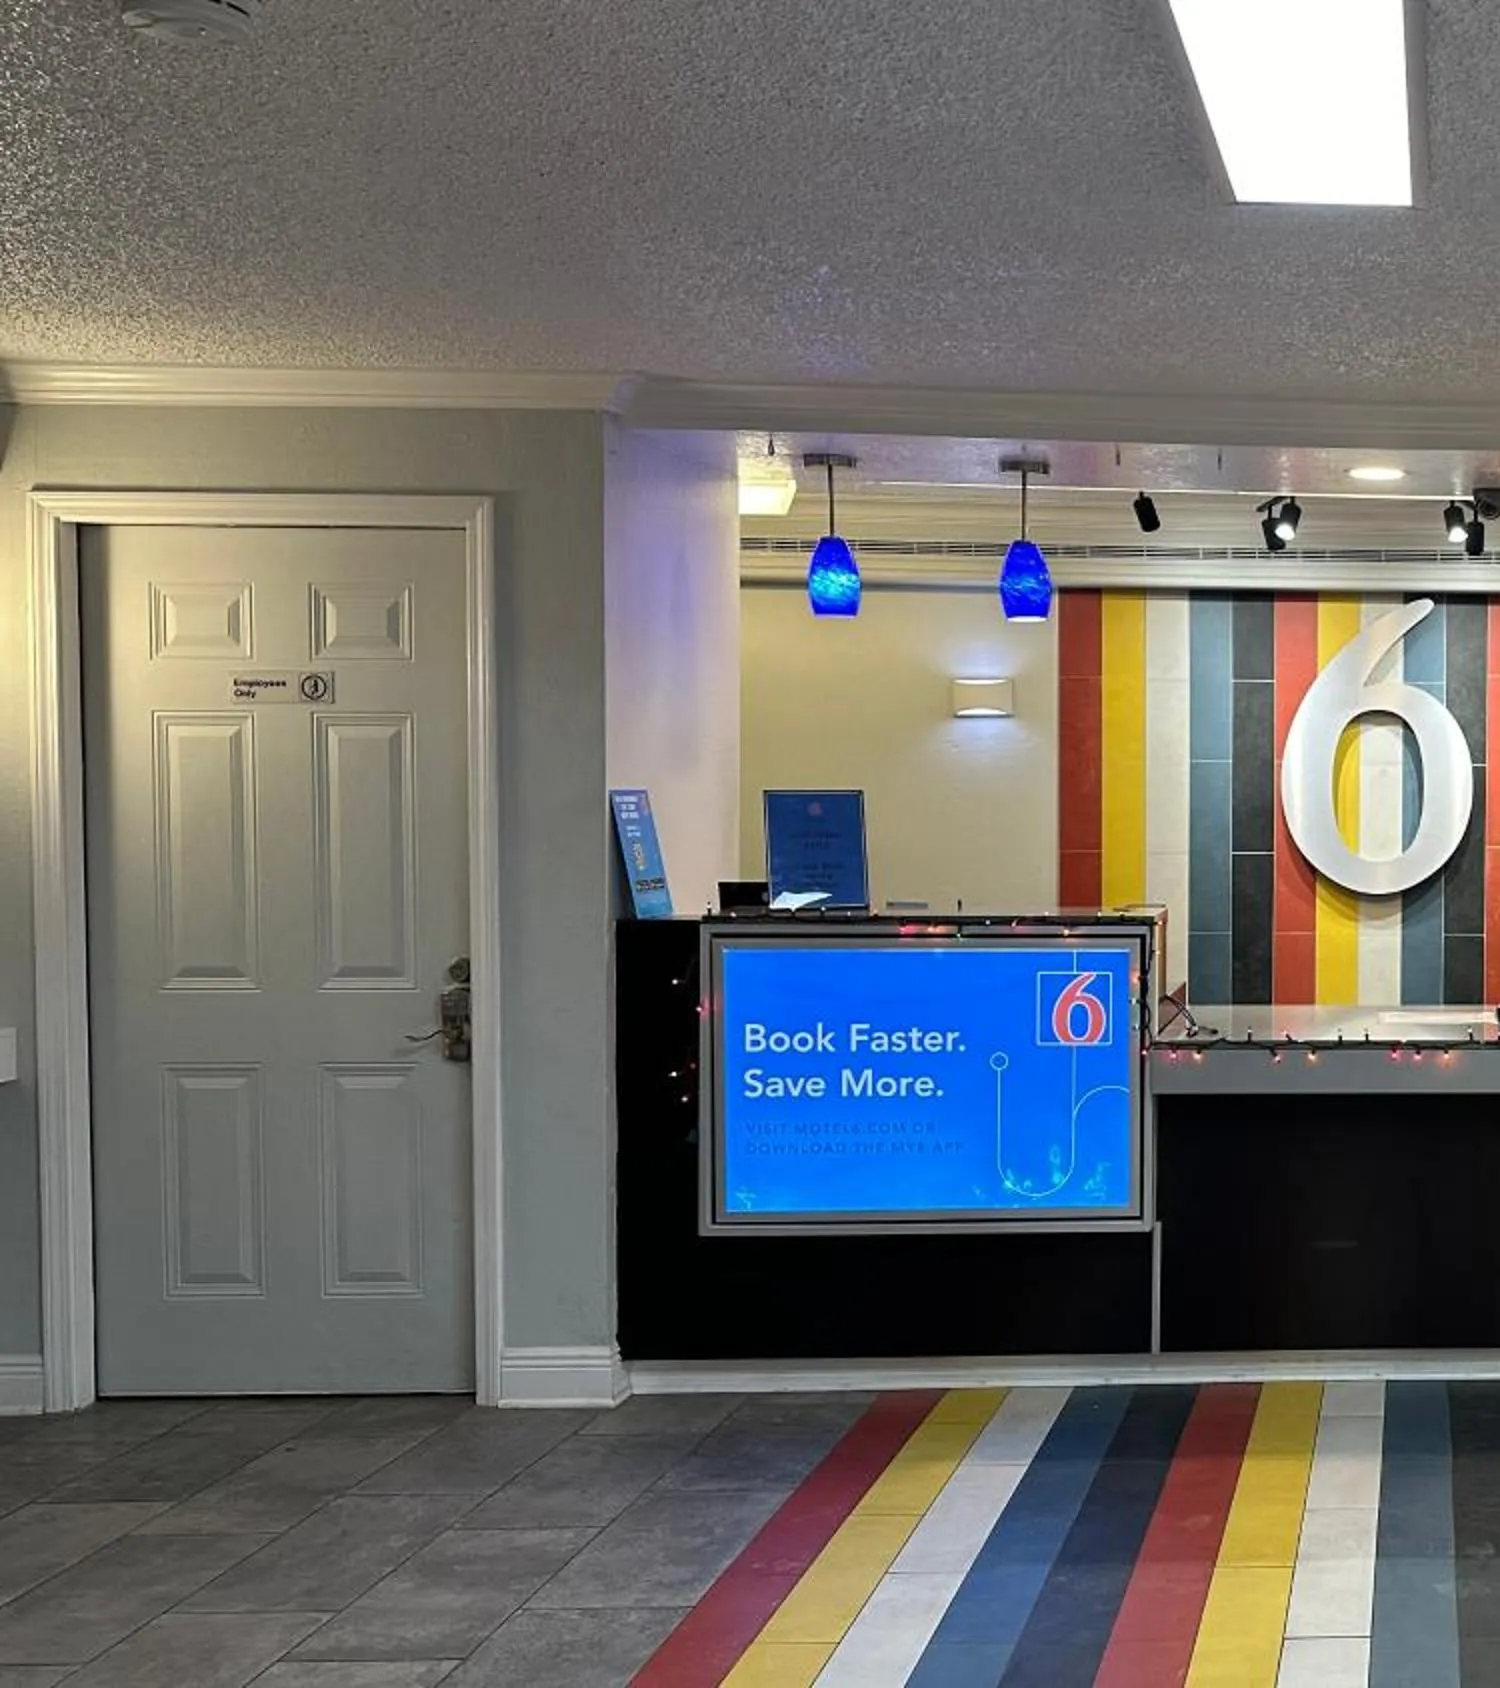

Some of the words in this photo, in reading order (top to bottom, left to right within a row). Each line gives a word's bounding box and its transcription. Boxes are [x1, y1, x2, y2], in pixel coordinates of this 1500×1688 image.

[233, 678, 287, 688] Employees
[233, 688, 257, 698] Only
[1281, 598, 1474, 895] 6
[1052, 972, 1106, 1043] 6
[744, 1021, 836, 1053] Book
[849, 1023, 967, 1053] Faster.
[743, 1068, 826, 1098] Save
[840, 1068, 945, 1098] More.
[745, 1121, 786, 1135] VISIT
[913, 1121, 937, 1135] OR
[745, 1140, 845, 1155] DOWNLOAD
[852, 1140, 884, 1154] THE
[932, 1140, 965, 1154] APP
